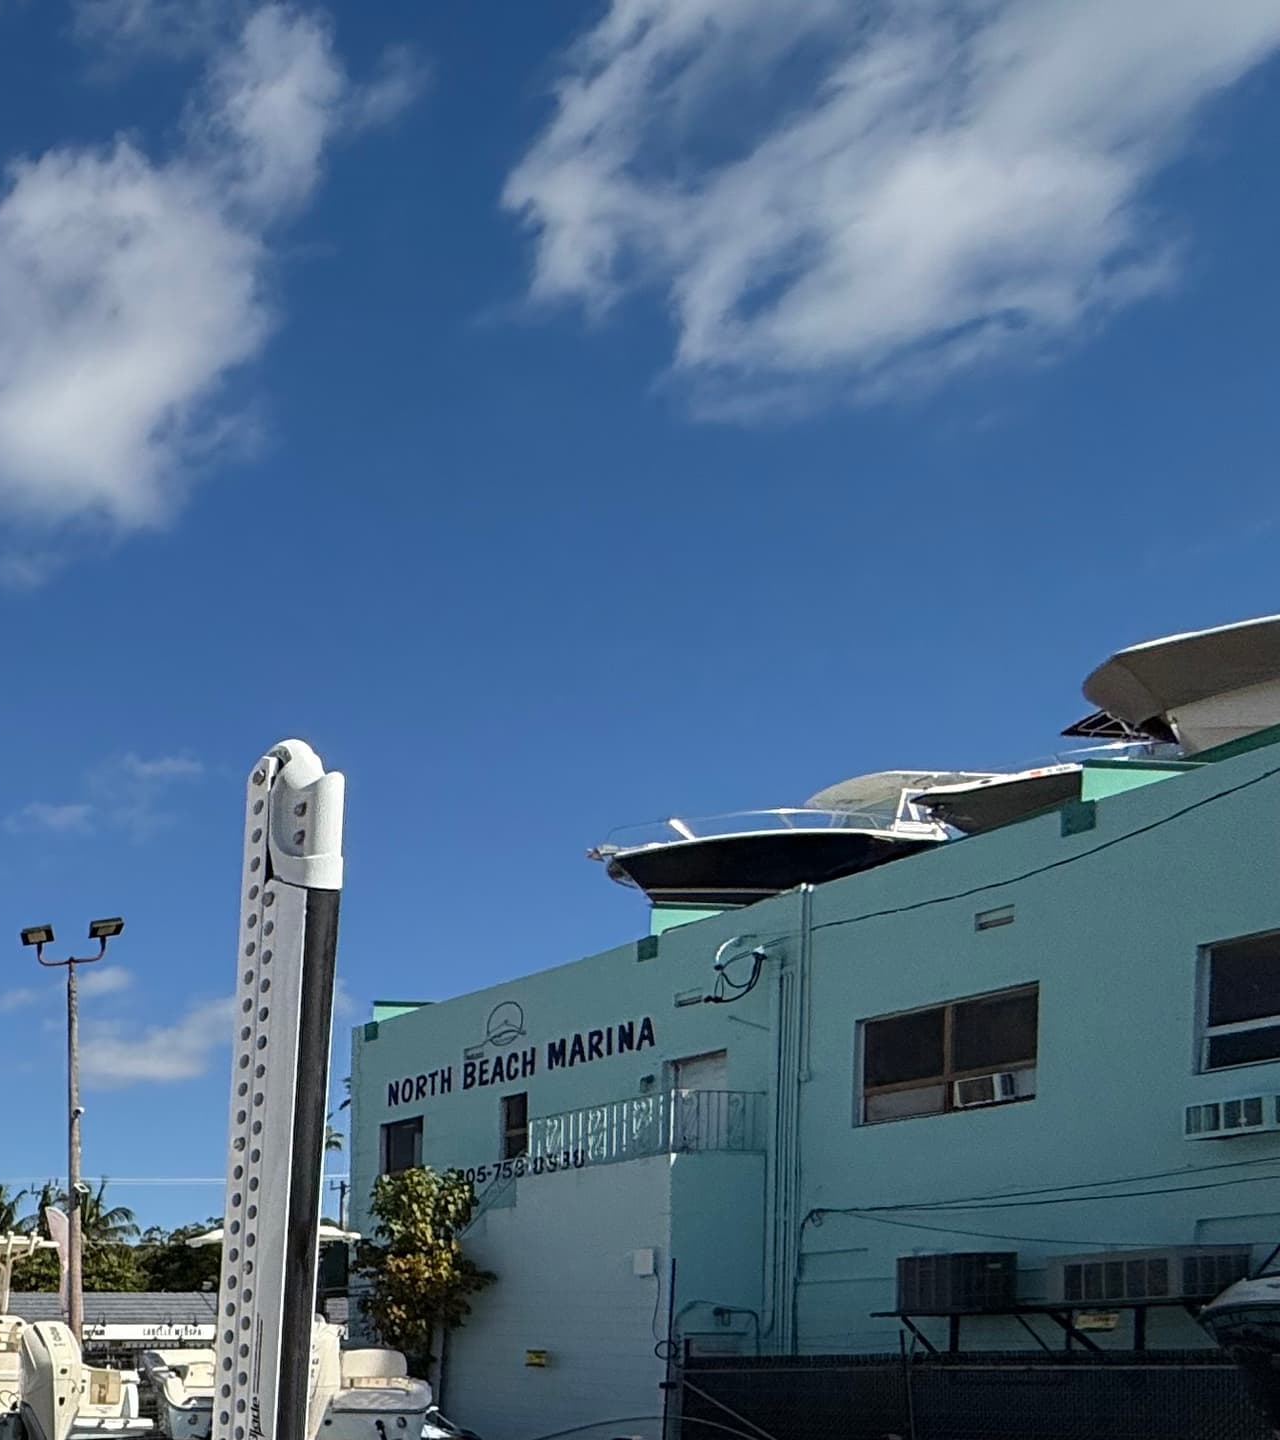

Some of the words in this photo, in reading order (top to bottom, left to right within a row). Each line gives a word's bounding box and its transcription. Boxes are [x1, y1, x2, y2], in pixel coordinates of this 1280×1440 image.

[388, 1066, 452, 1107] NORTH
[462, 1046, 536, 1091] BEACH
[547, 1016, 656, 1071] MARINA
